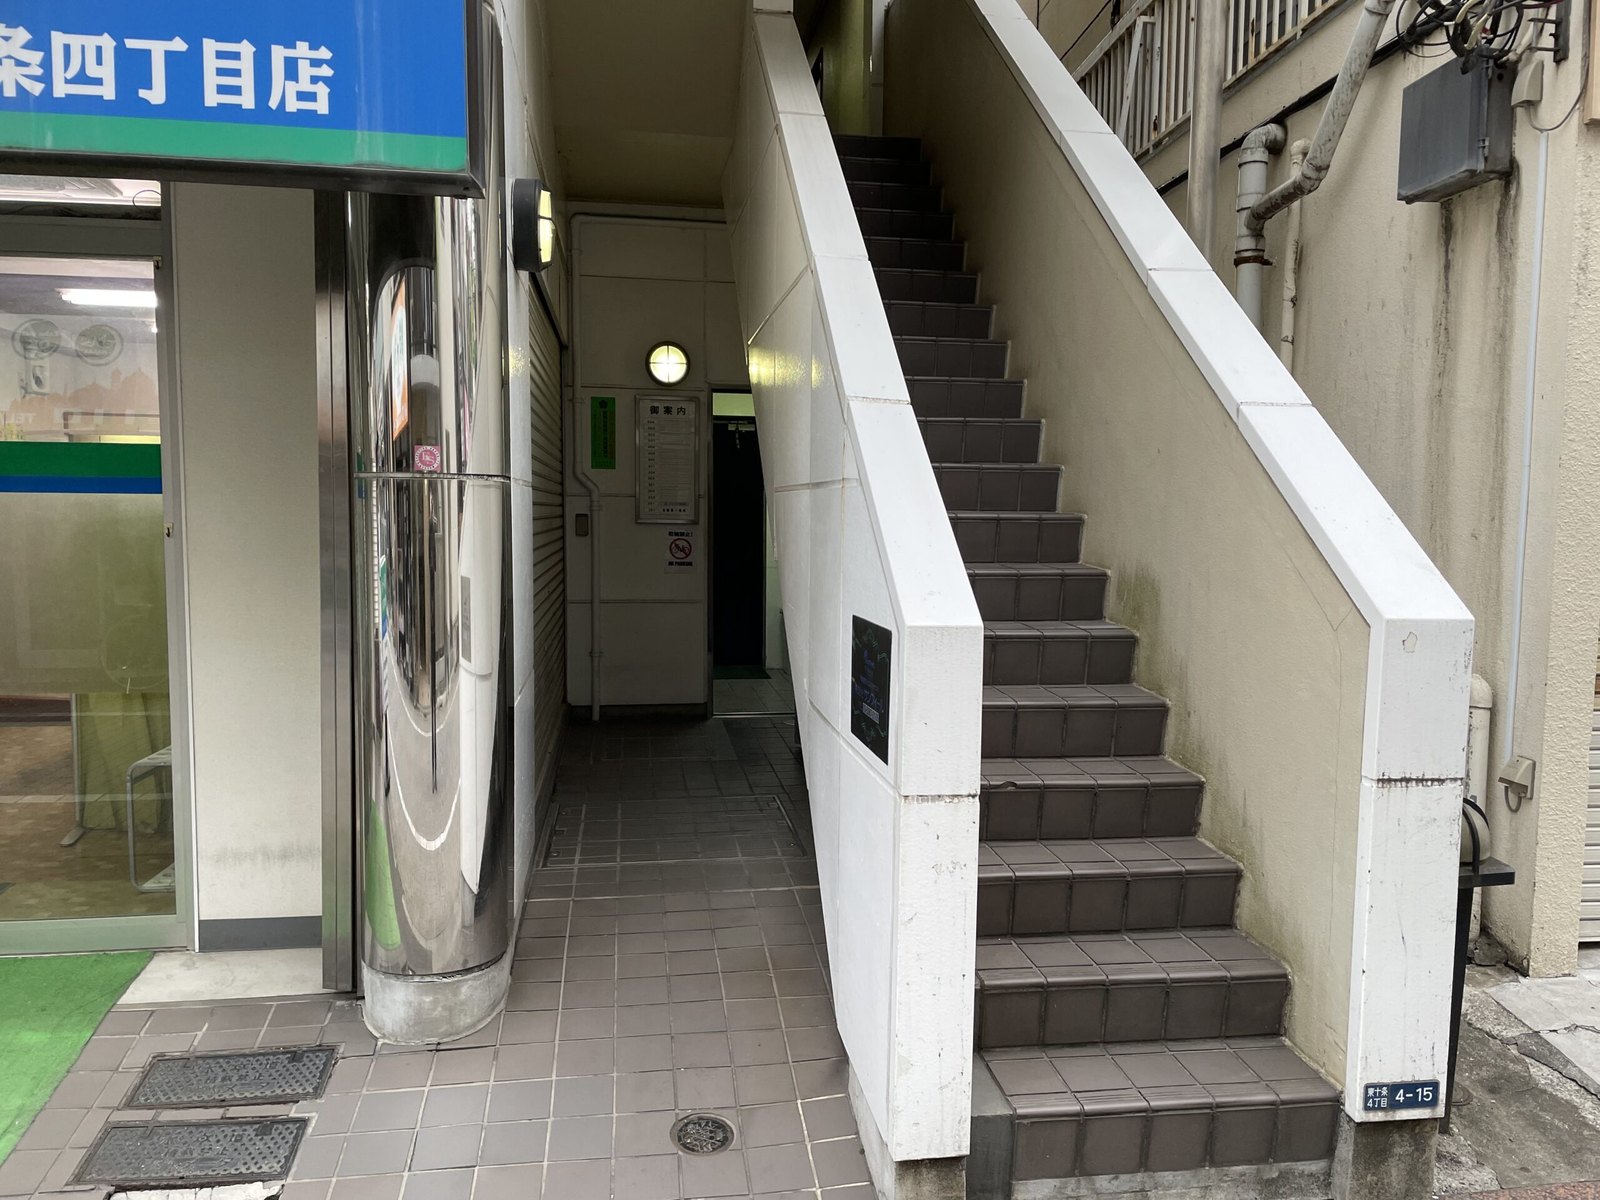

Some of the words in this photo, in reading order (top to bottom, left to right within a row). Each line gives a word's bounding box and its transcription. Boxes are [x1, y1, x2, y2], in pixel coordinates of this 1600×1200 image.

[0, 23, 334, 115] 条四丁目店
[649, 405, 686, 416] 御案内
[1367, 1086, 1388, 1097] 東十条
[1395, 1087, 1433, 1103] 4-15
[1367, 1098, 1388, 1108] 4丁目
